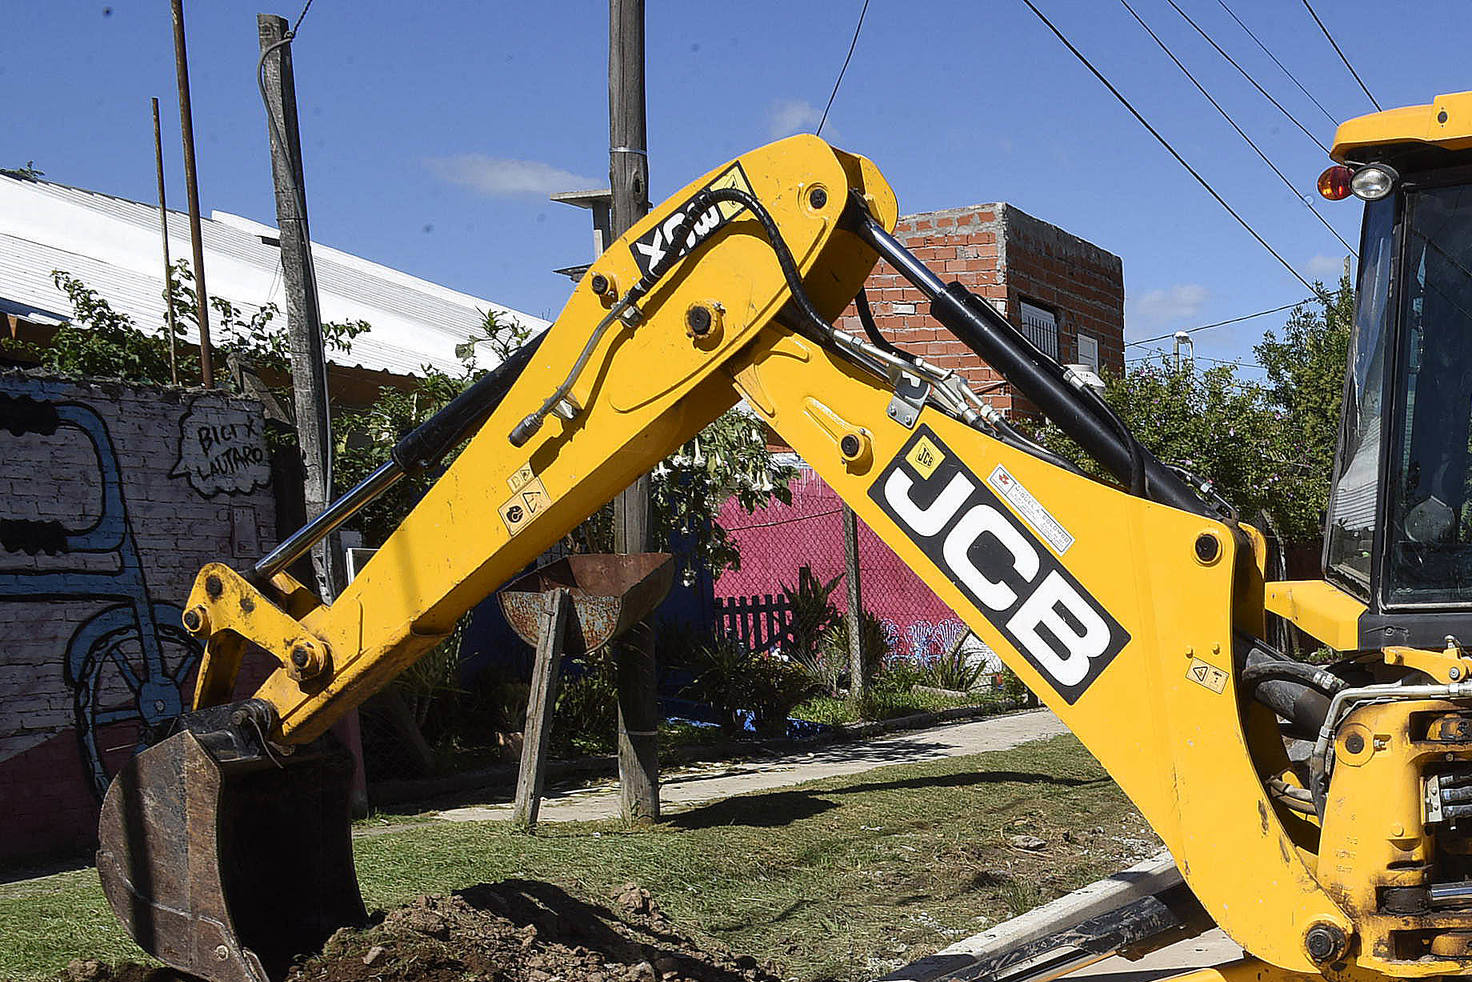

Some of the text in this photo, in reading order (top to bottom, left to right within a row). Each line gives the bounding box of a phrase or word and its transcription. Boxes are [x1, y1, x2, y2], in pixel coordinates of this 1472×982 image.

[198, 414, 259, 457] BICI X
[196, 446, 264, 481] LAUTARO
[917, 447, 934, 467] JCB
[884, 466, 1111, 687] JCB
